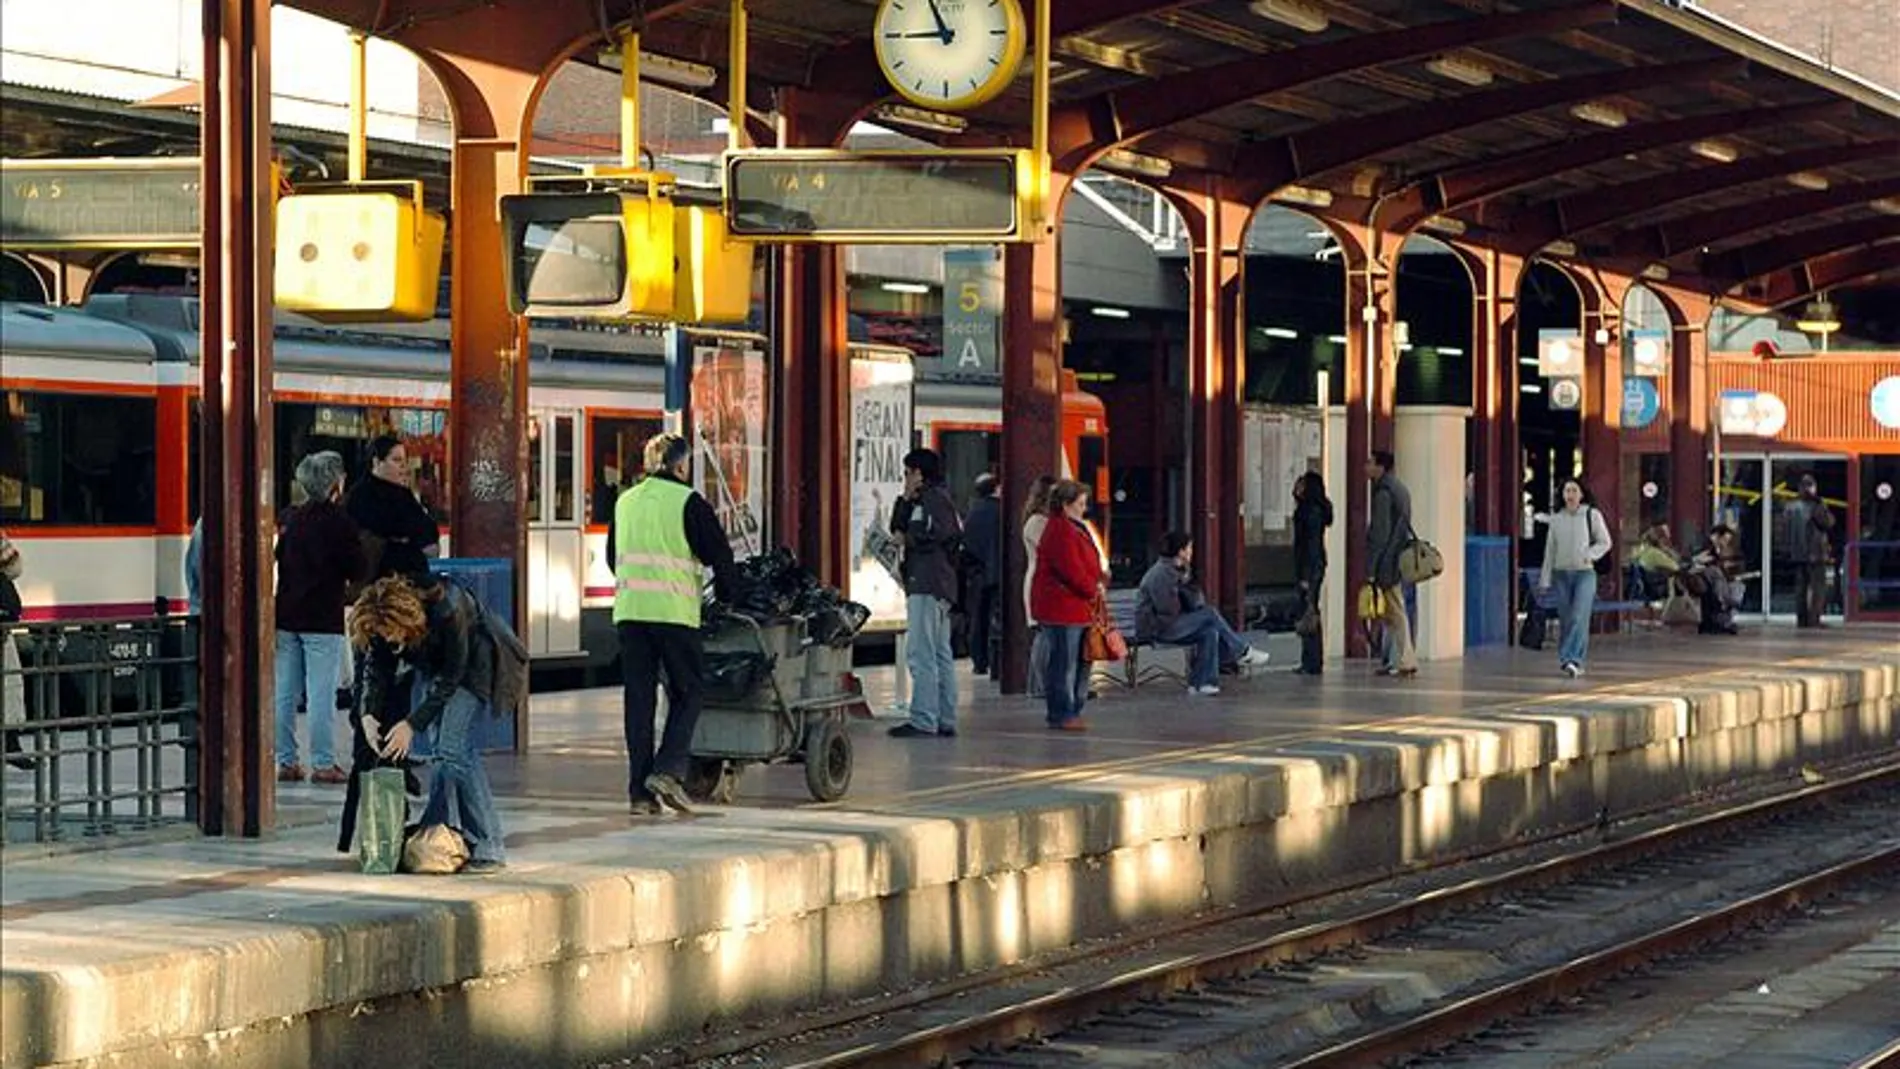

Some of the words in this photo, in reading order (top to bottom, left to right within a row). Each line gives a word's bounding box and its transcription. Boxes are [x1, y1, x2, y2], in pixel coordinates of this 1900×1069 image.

[51, 179, 63, 198] 5
[811, 172, 825, 190] 4
[959, 282, 981, 312] 5
[959, 338, 981, 367] A
[863, 400, 906, 438] GRAN
[854, 439, 904, 482] FINAL
